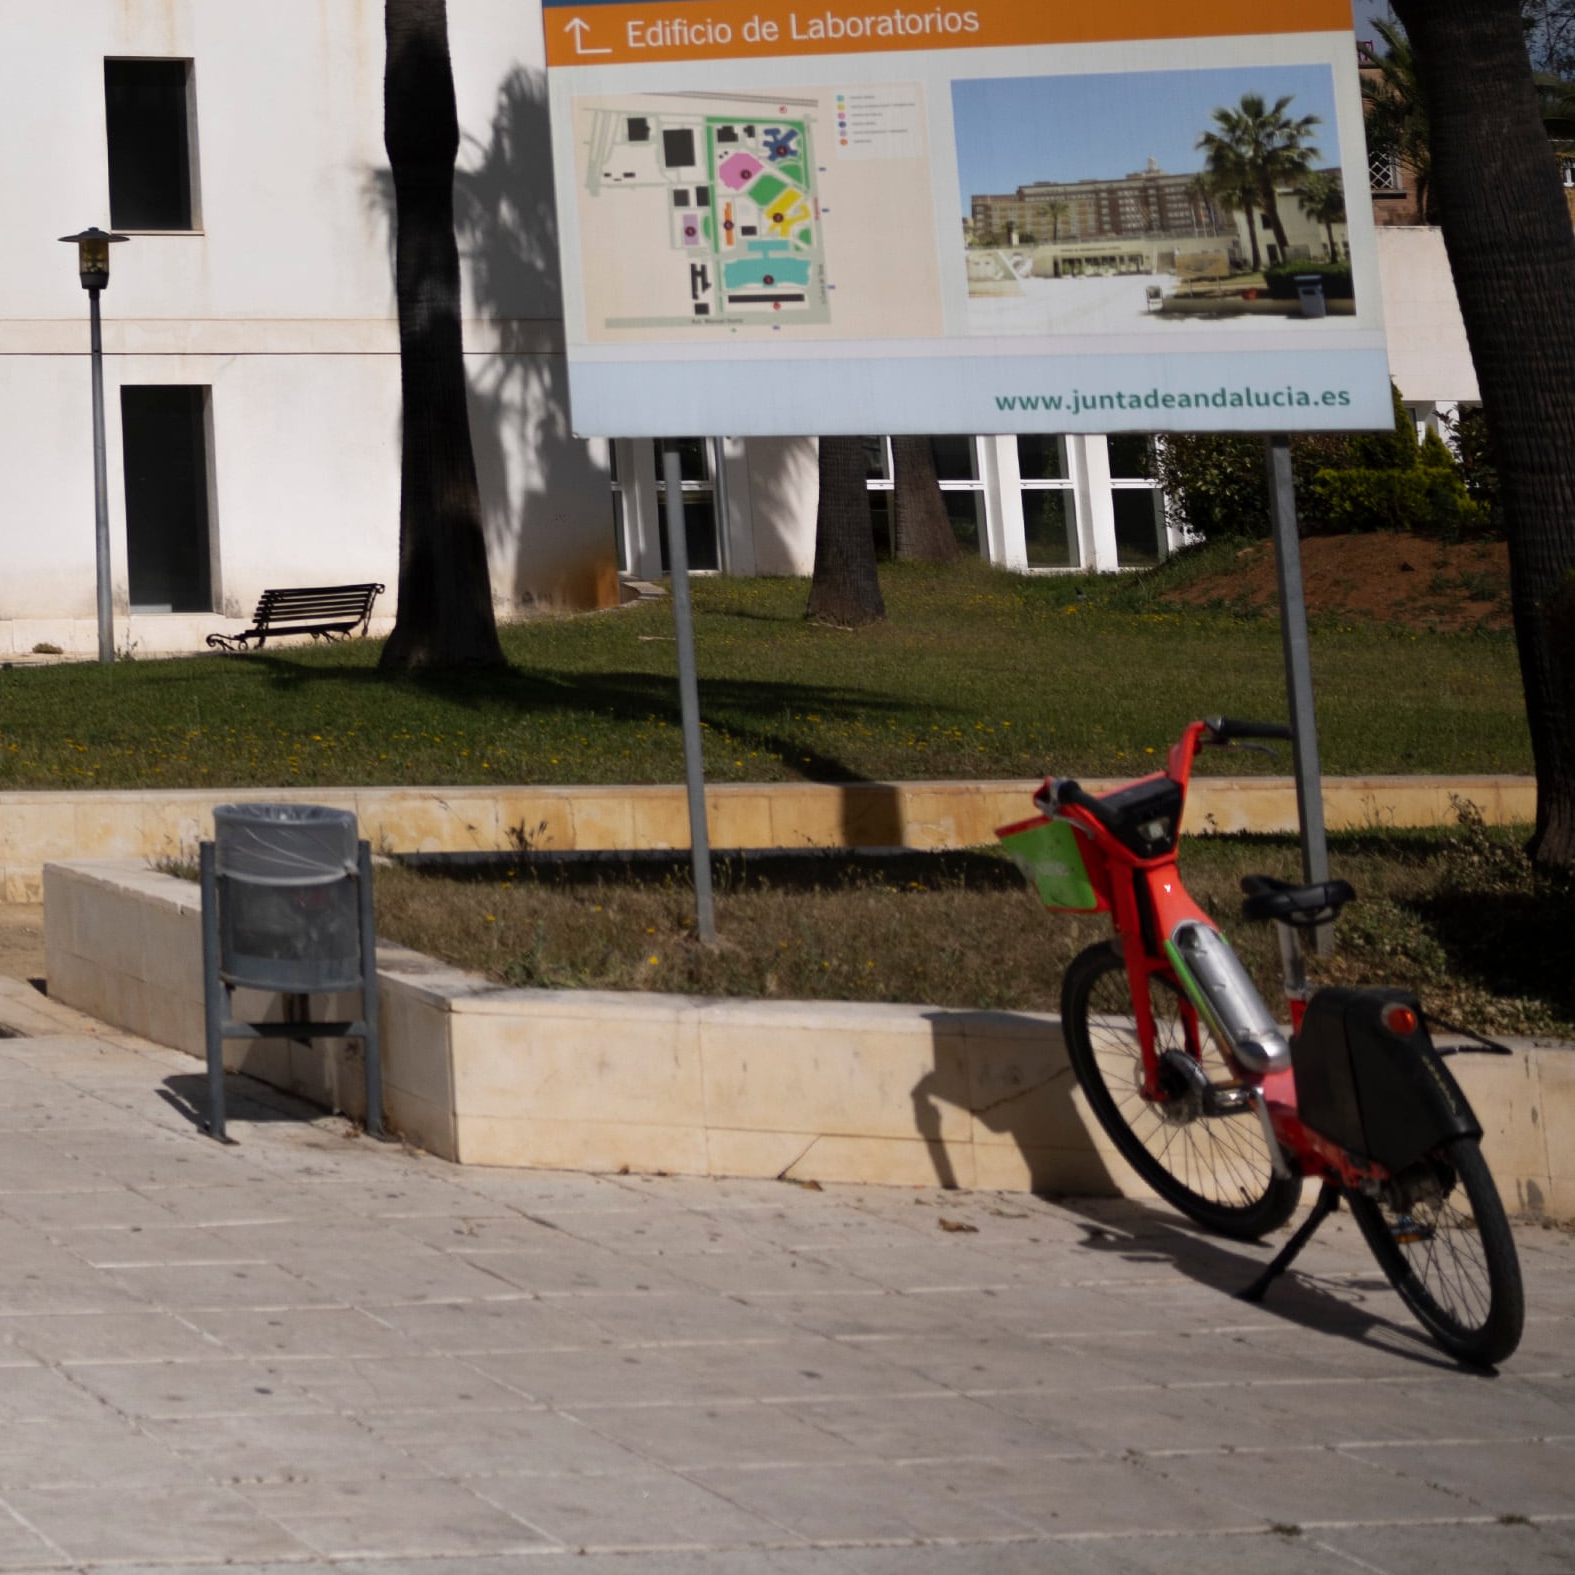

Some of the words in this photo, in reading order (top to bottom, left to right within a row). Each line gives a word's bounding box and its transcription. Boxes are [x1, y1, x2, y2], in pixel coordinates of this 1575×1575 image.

[626, 18, 733, 48] Edificio
[741, 15, 780, 42] de
[790, 6, 980, 40] Laboratorios
[995, 385, 1351, 415] www.juntadeandalucia.es
